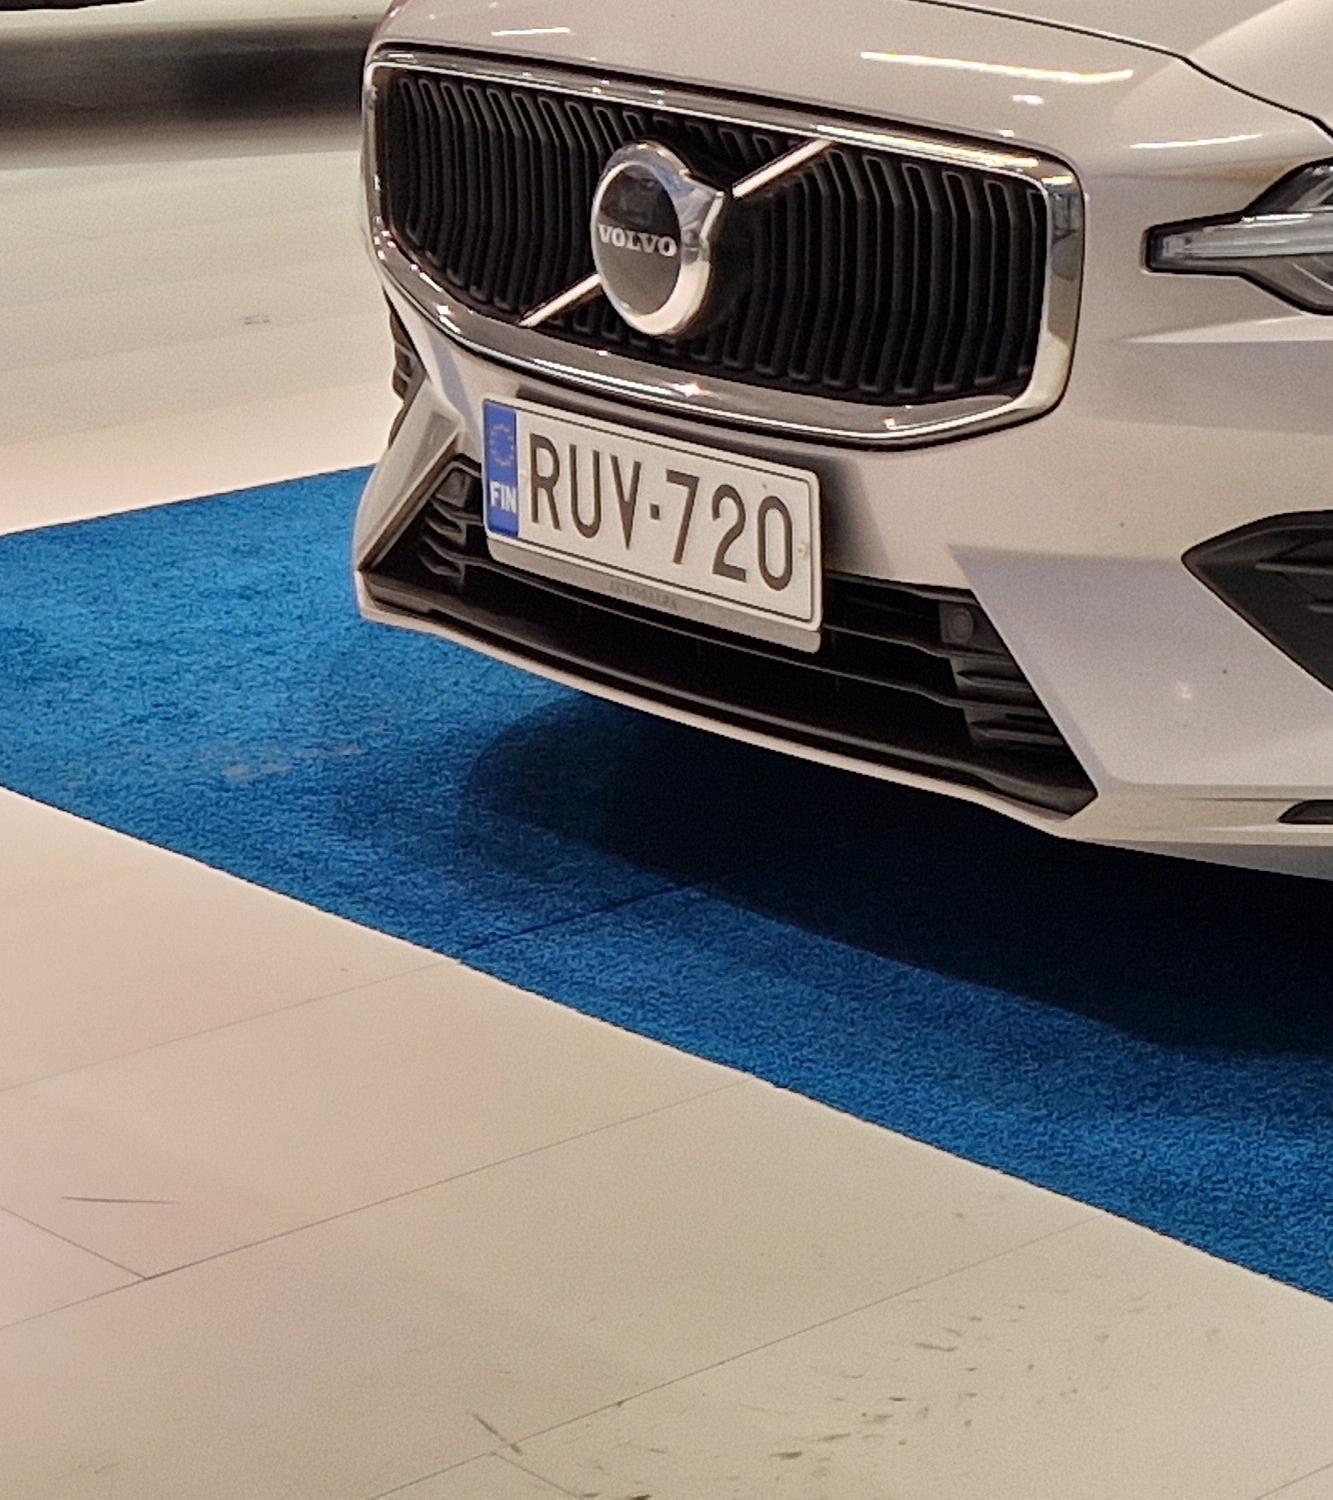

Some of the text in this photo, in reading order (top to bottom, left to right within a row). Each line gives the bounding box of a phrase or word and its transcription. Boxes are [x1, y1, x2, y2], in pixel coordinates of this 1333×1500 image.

[597, 223, 677, 258] VOLVO
[489, 480, 518, 512] FIN
[529, 432, 794, 592] RUV-720
